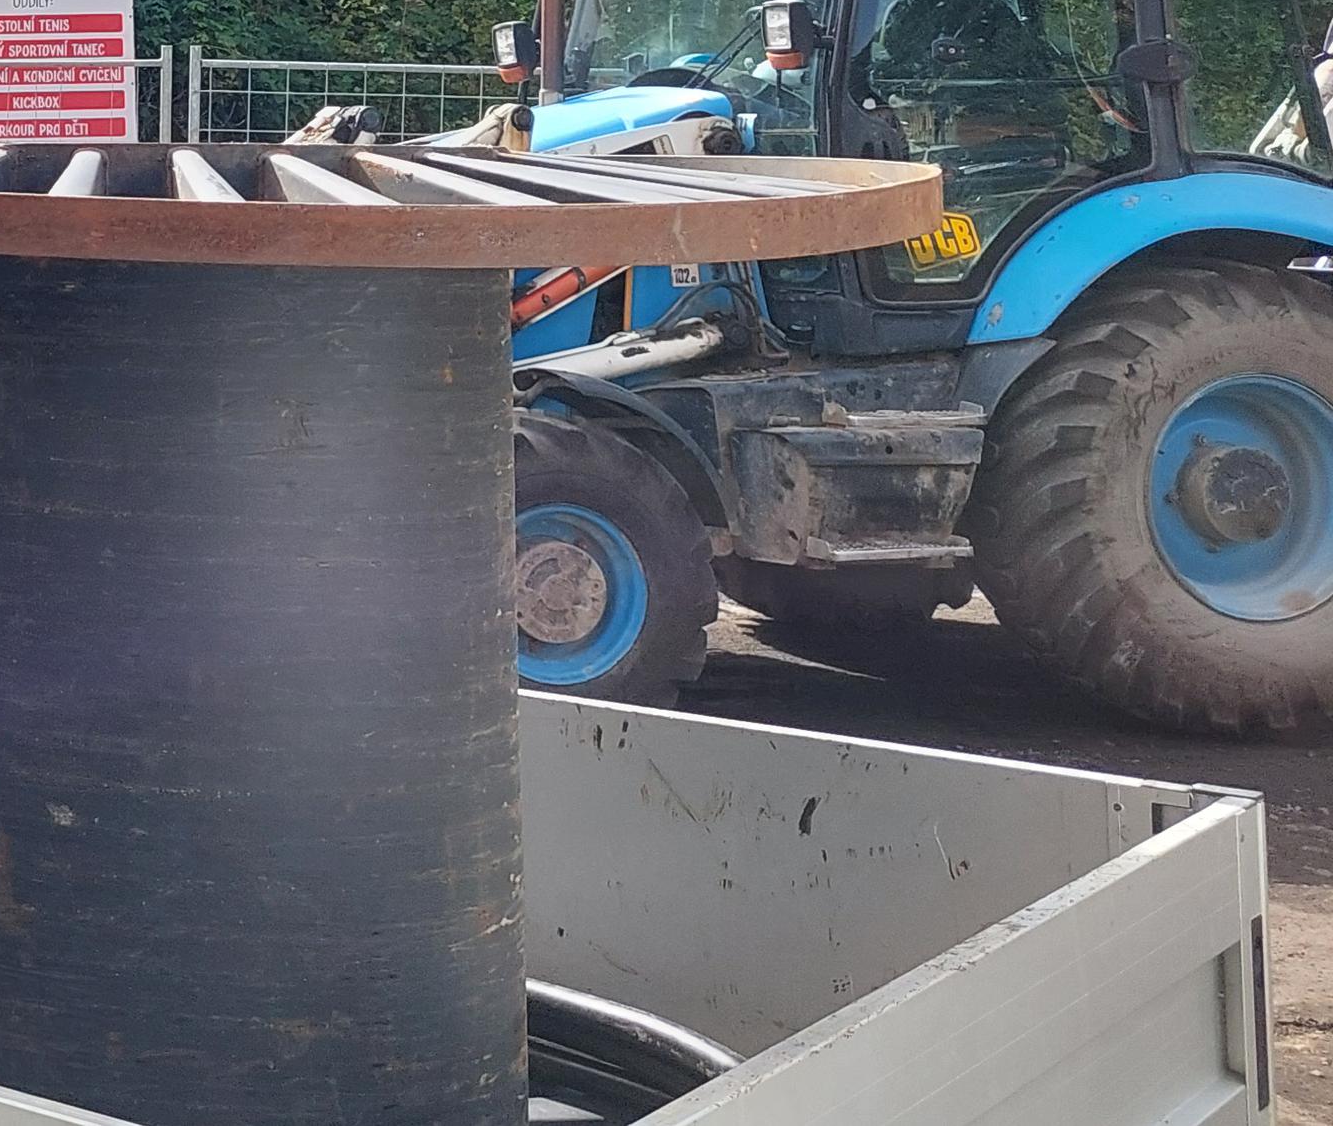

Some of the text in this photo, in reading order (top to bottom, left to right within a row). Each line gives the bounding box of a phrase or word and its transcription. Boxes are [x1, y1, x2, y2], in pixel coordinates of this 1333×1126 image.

[39, 19, 70, 31] TENIS
[9, 41, 67, 57] SPORTOVNÍ
[71, 43, 105, 56] TANEC
[12, 71, 20, 83] A
[12, 96, 60, 109] KICKBOX
[39, 123, 60, 136] PRO
[65, 119, 89, 136] DĚTI
[911, 219, 974, 264] JCB
[673, 268, 690, 283] 102
